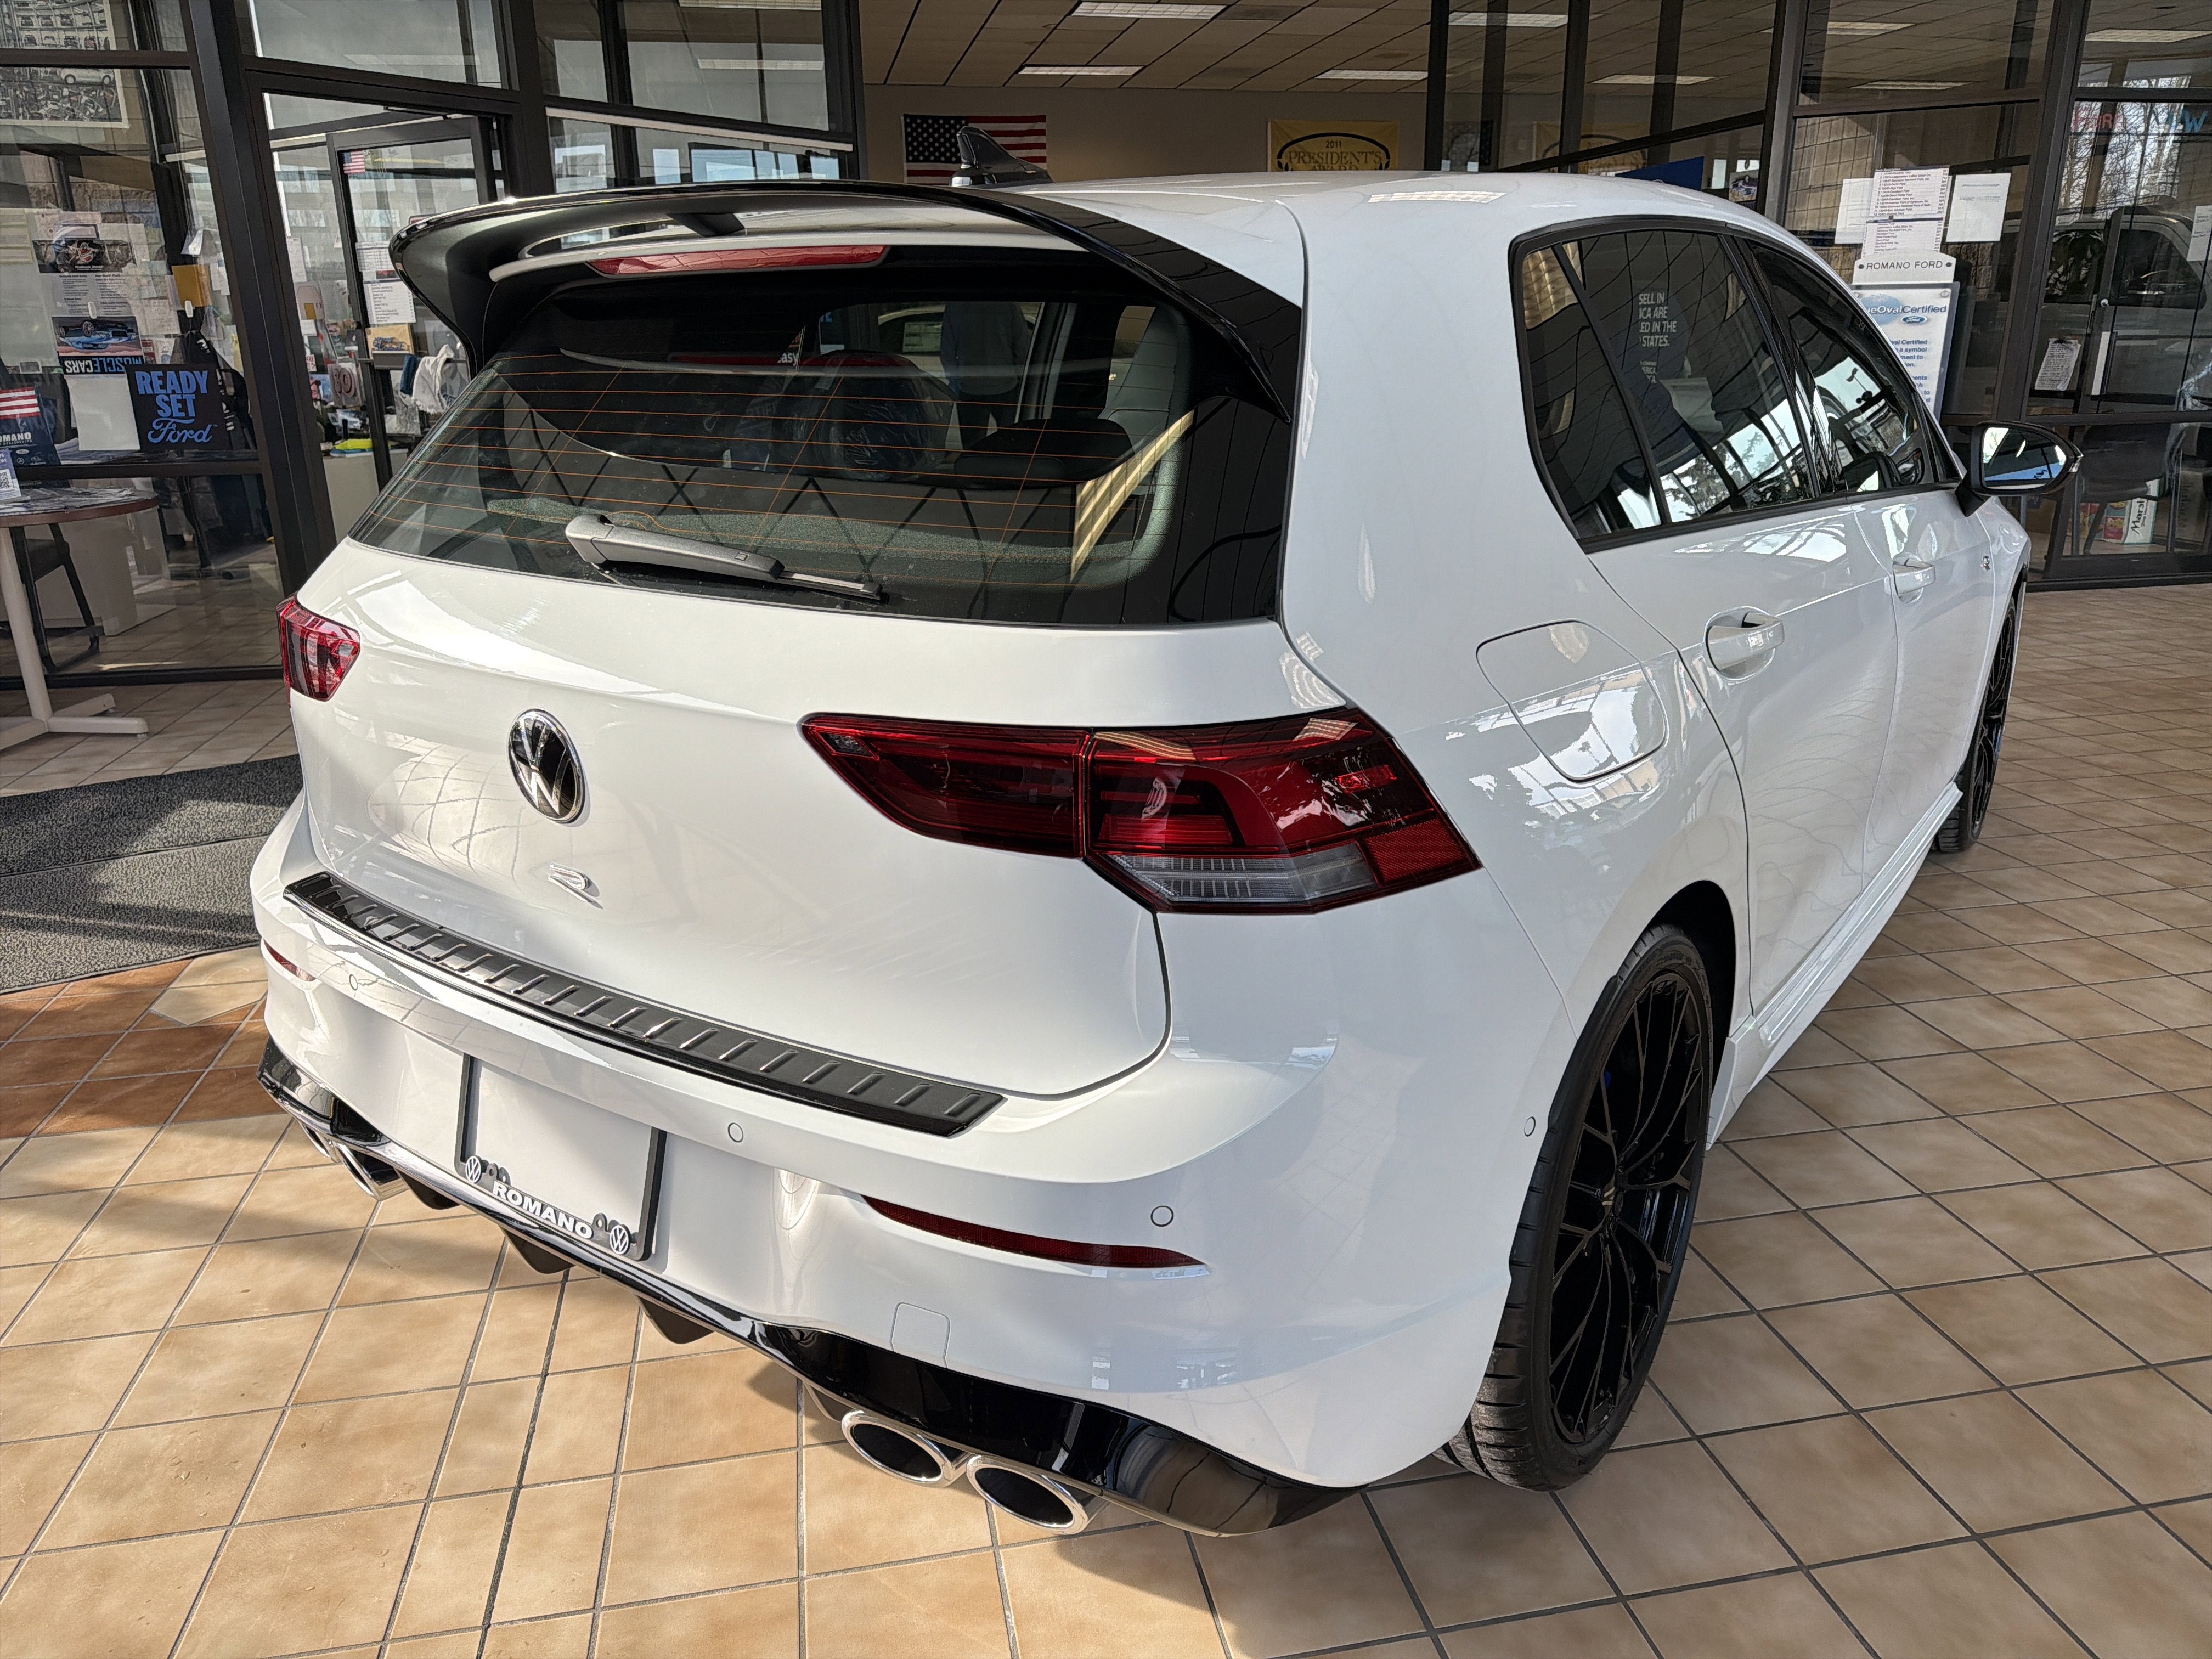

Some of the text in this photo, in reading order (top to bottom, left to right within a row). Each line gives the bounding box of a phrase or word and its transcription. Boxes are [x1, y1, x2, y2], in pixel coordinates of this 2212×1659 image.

[1289, 151, 1383, 165] PRESIDENT'S
[1866, 261, 1943, 270] ROMANO FORD
[1639, 292, 1664, 305] SELL IN
[1653, 306, 1668, 319] ARE
[1652, 321, 1661, 332] IN
[1662, 321, 1677, 333] THE
[135, 370, 208, 394] READY
[156, 394, 196, 417] SET
[148, 417, 213, 444] Ford
[493, 1180, 593, 1239] ROMANO
